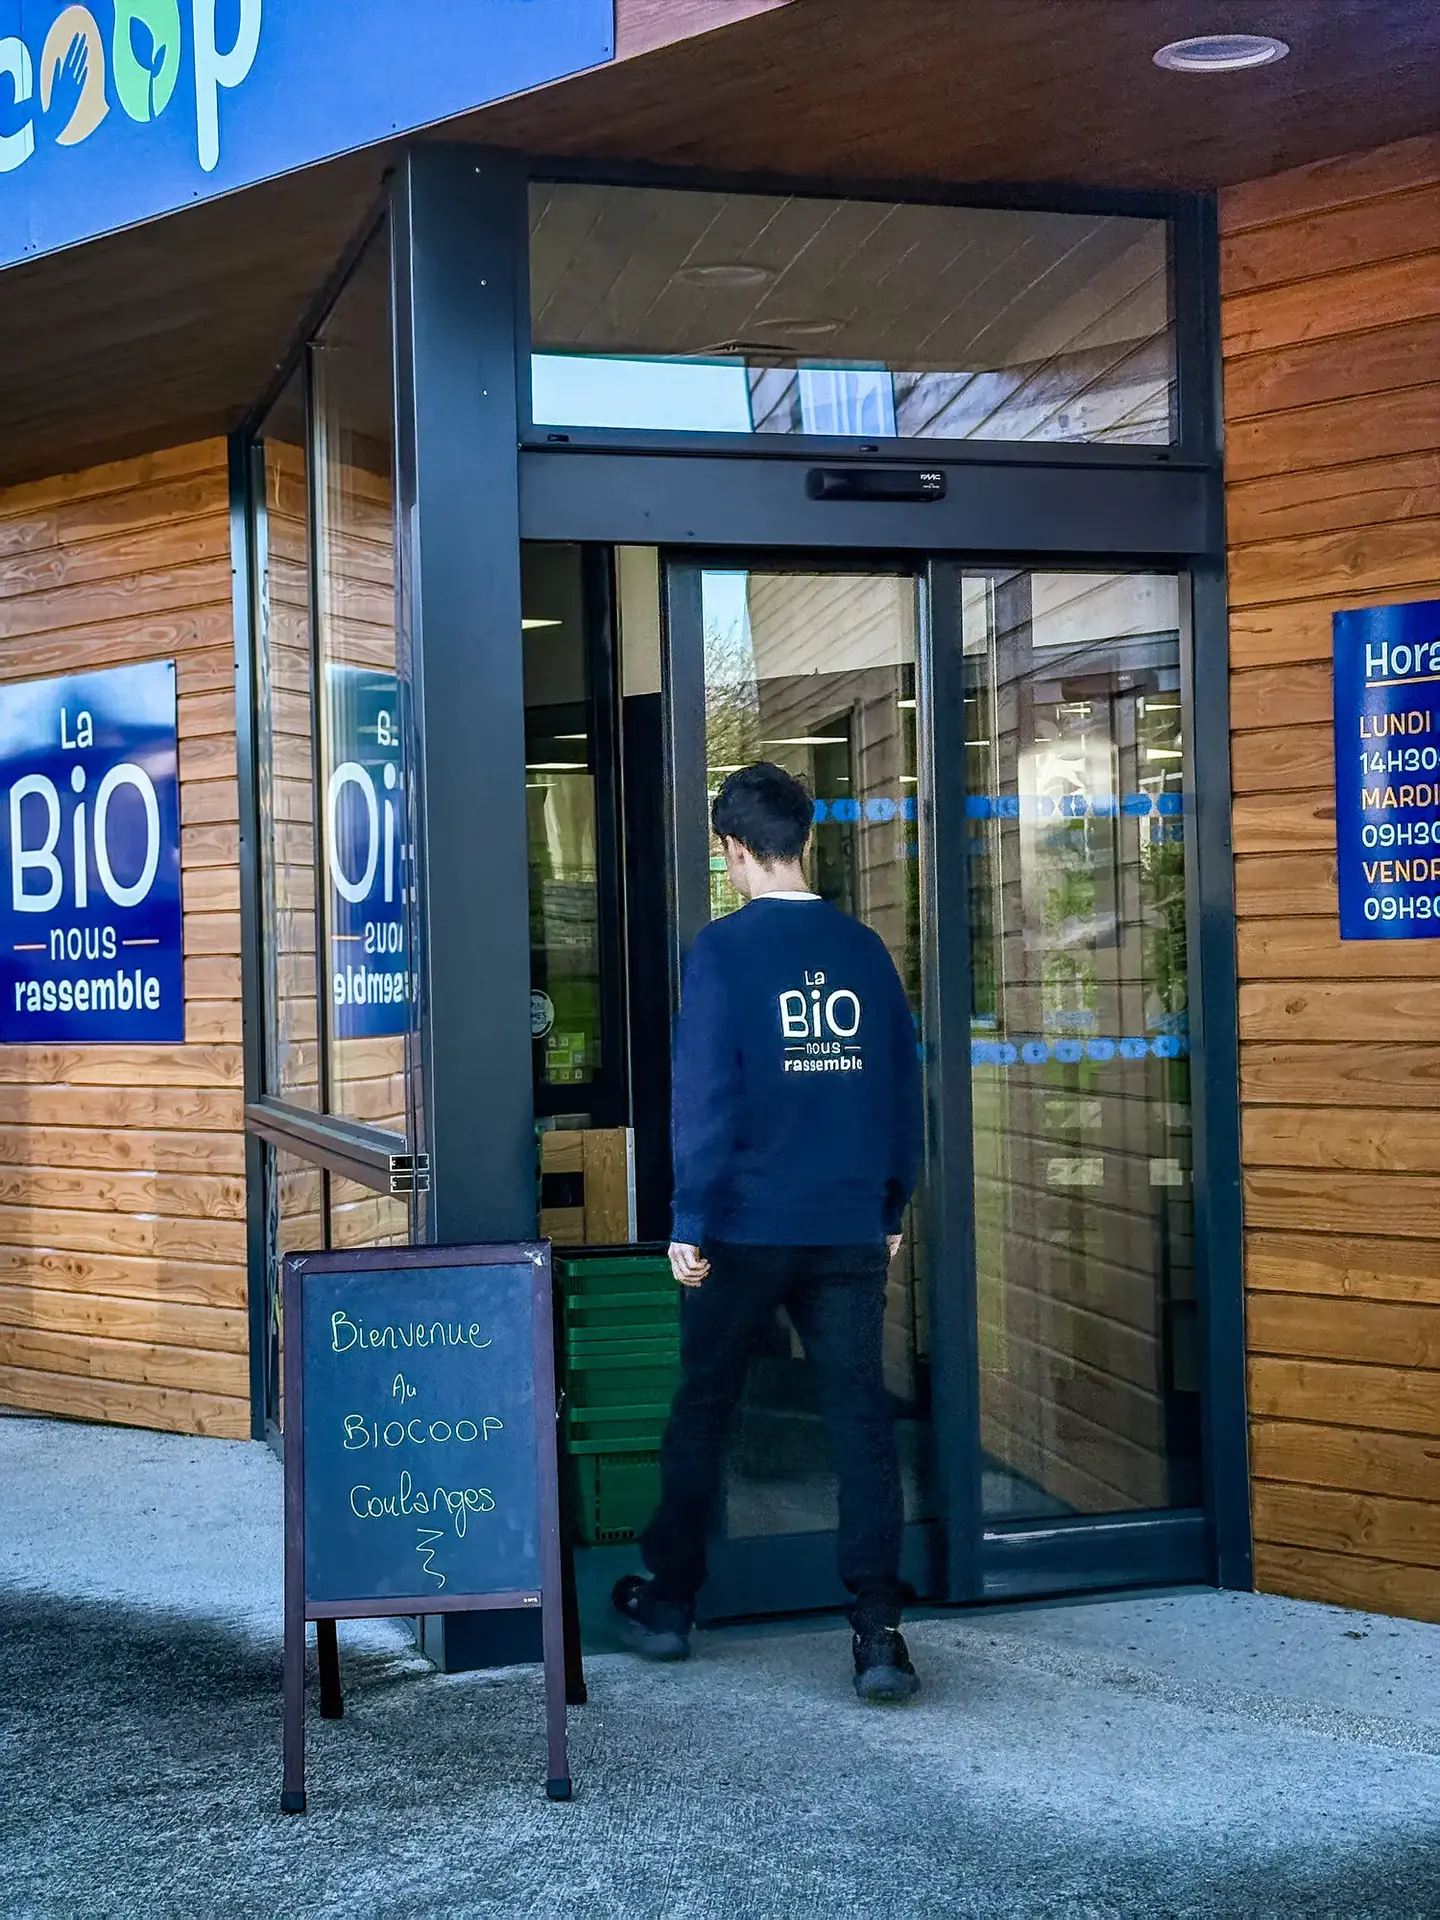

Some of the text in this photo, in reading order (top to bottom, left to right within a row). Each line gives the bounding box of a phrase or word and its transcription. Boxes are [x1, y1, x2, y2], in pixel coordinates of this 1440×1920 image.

[1365, 641, 1440, 677] Hora
[60, 707, 94, 749] La
[1360, 710, 1430, 738] LUNDI
[1359, 747, 1440, 775] 14H30
[1361, 783, 1439, 811] MARDI
[9, 762, 161, 913] BiO
[50, 925, 117, 961] nous
[15, 968, 161, 1012] rassemble
[804, 970, 825, 986] La
[779, 988, 861, 1038] BiO
[784, 1055, 863, 1072] rassemble
[806, 1041, 841, 1054] nous
[330, 1310, 493, 1352] Bienvenue
[392, 1373, 417, 1404] Au
[343, 1414, 504, 1450] BIOCOOP
[349, 1470, 497, 1538] Coulanges
